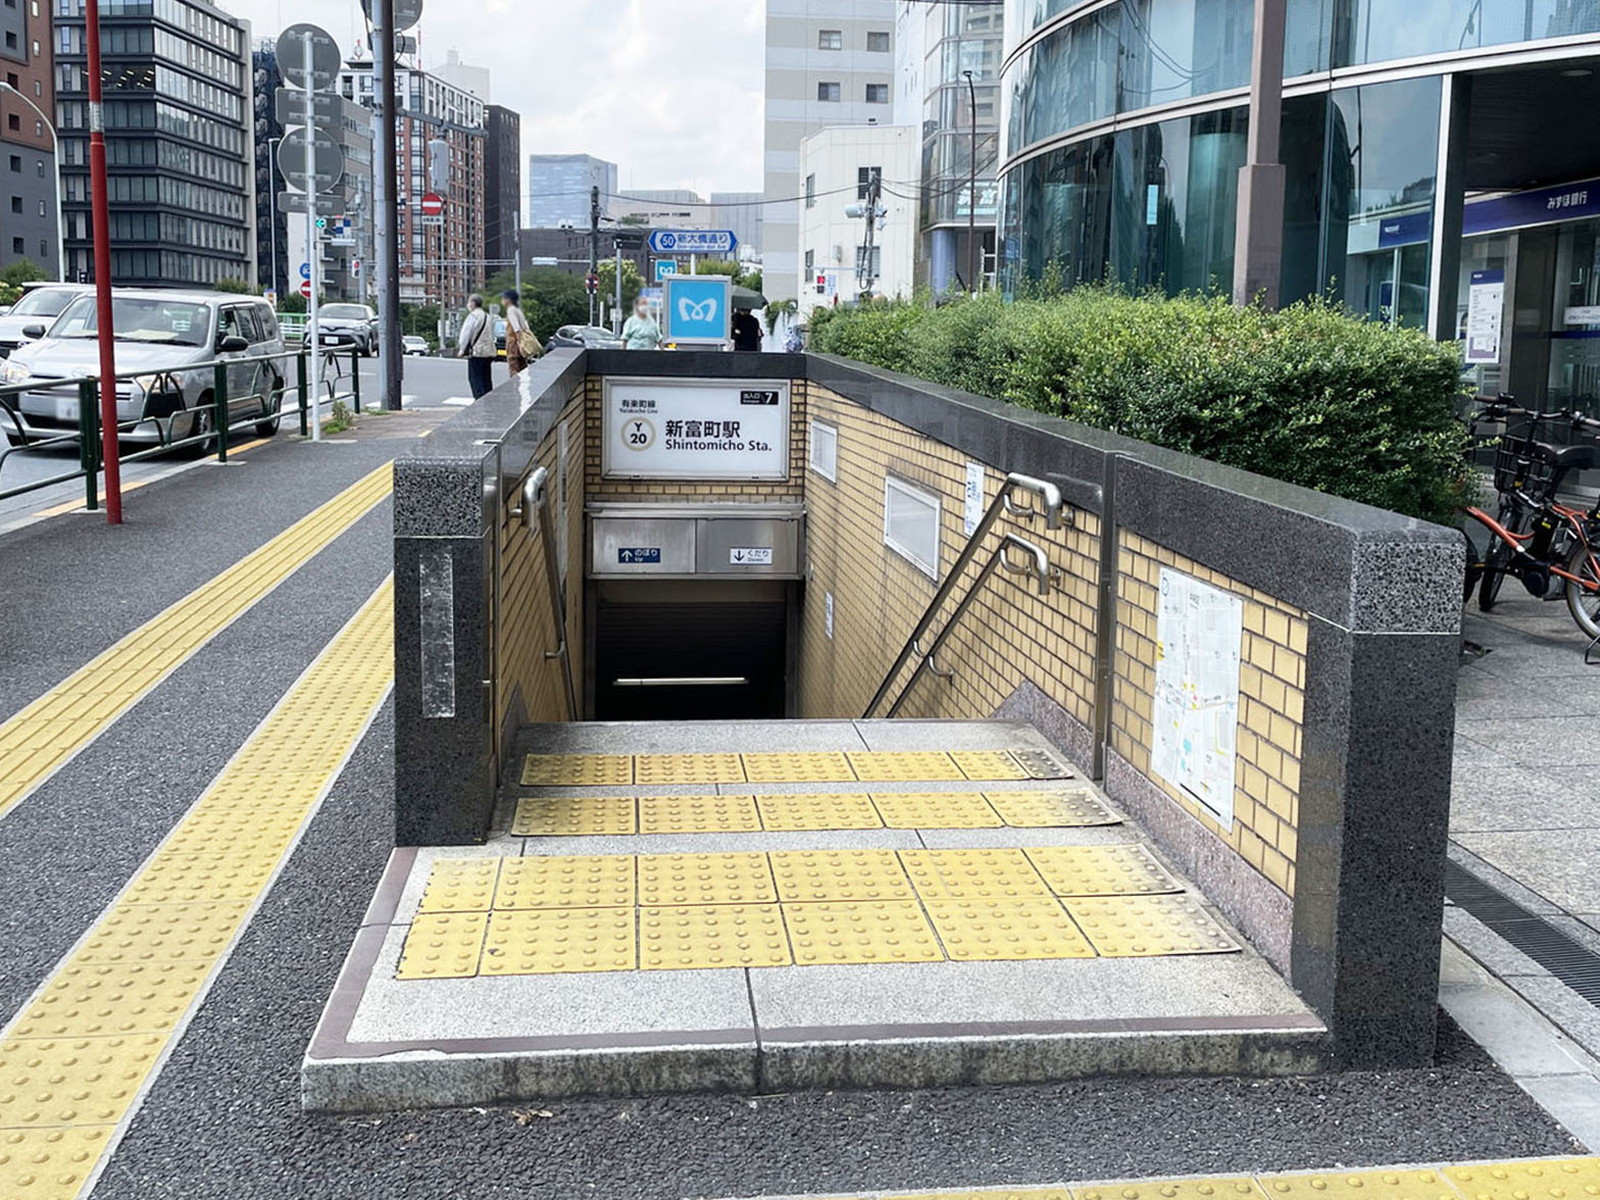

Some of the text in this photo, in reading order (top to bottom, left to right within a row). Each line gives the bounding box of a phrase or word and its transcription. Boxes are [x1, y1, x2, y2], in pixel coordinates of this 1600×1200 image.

[1546, 191, 1588, 210] みずほ銀行
[662, 235, 674, 246] 50
[677, 233, 728, 244] 新大橋通り
[764, 392, 773, 404] 7
[634, 422, 643, 432] Y
[665, 420, 740, 438] 新富町駅
[630, 433, 647, 444] 20
[665, 439, 772, 452] Shintomicho Sta.
[634, 548, 658, 557] のぼり
[747, 549, 769, 557] くだり
